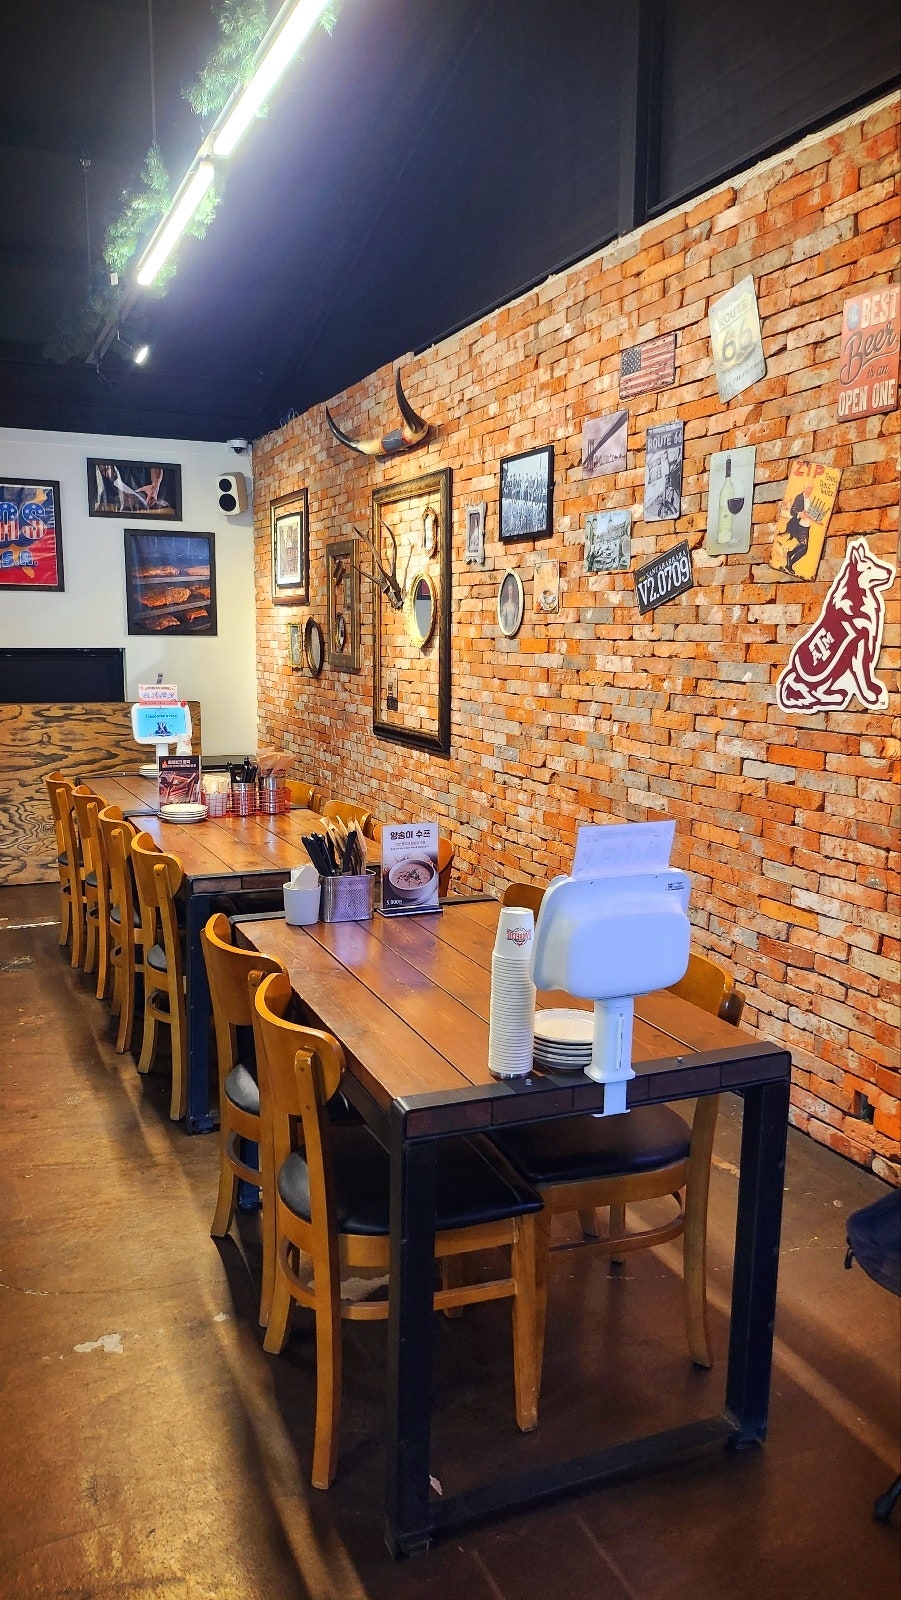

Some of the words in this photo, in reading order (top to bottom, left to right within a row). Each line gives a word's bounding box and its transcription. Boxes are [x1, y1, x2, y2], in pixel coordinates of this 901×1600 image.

[718, 299, 751, 329] ROUTE
[861, 287, 899, 328] BEST
[721, 319, 756, 363] 66
[840, 321, 898, 386] Beer
[866, 364, 875, 380] is
[877, 364, 889, 377] an
[837, 385, 868, 417] OPEN
[871, 379, 897, 409] ONE
[646, 434, 672, 452] ROUTE
[673, 430, 684, 446] 66
[795, 460, 826, 479] ZIP
[637, 556, 689, 605] V2.0709
[415, 829, 431, 838] 수프
